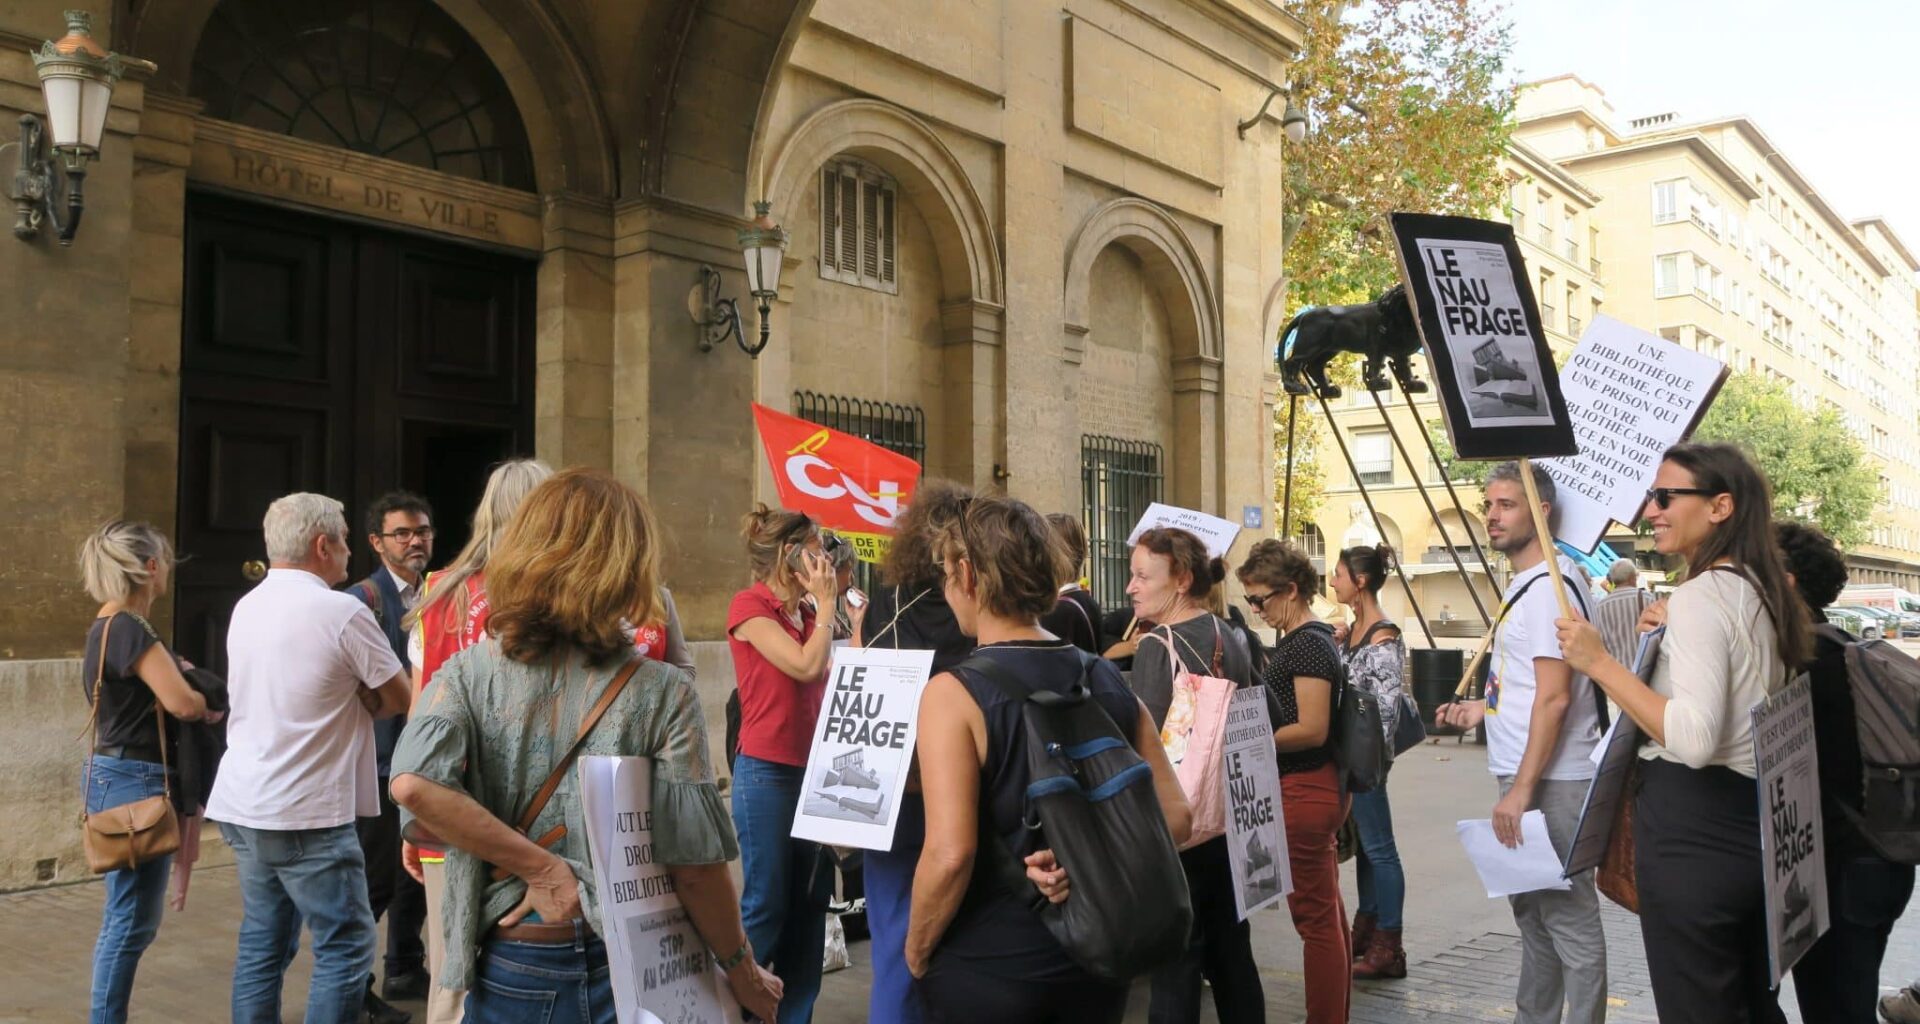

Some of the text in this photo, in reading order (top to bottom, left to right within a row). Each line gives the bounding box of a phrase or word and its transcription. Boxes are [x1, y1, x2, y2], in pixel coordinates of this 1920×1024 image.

[363, 184, 403, 213] DE
[418, 196, 499, 234] VILLE
[1427, 248, 1461, 278] LE
[1434, 277, 1491, 307] NAU
[1443, 306, 1527, 336] FRAGE
[1637, 342, 1668, 363] UNE
[1573, 353, 1600, 373] QUI
[1601, 365, 1650, 396] FERME,
[1571, 370, 1681, 425] UNE PRISON QUI
[1592, 398, 1641, 427] OUVRE
[1598, 435, 1619, 452] EN
[1621, 444, 1654, 468] VOIE
[1591, 470, 1617, 489] PAS
[855, 537, 875, 549] DE
[835, 665, 868, 692] LE
[829, 691, 885, 720] NAU
[822, 716, 909, 749] FRAGE
[1226, 752, 1242, 781] LE
[1229, 775, 1256, 808] NAU
[1769, 775, 1785, 816] LE
[1234, 796, 1274, 835] FRAGE
[1772, 801, 1798, 846] NAU
[1775, 821, 1814, 883] FRAGE
[613, 872, 676, 904] BIBLIOTH
[659, 932, 684, 957] STOP
[643, 966, 657, 993] AU
